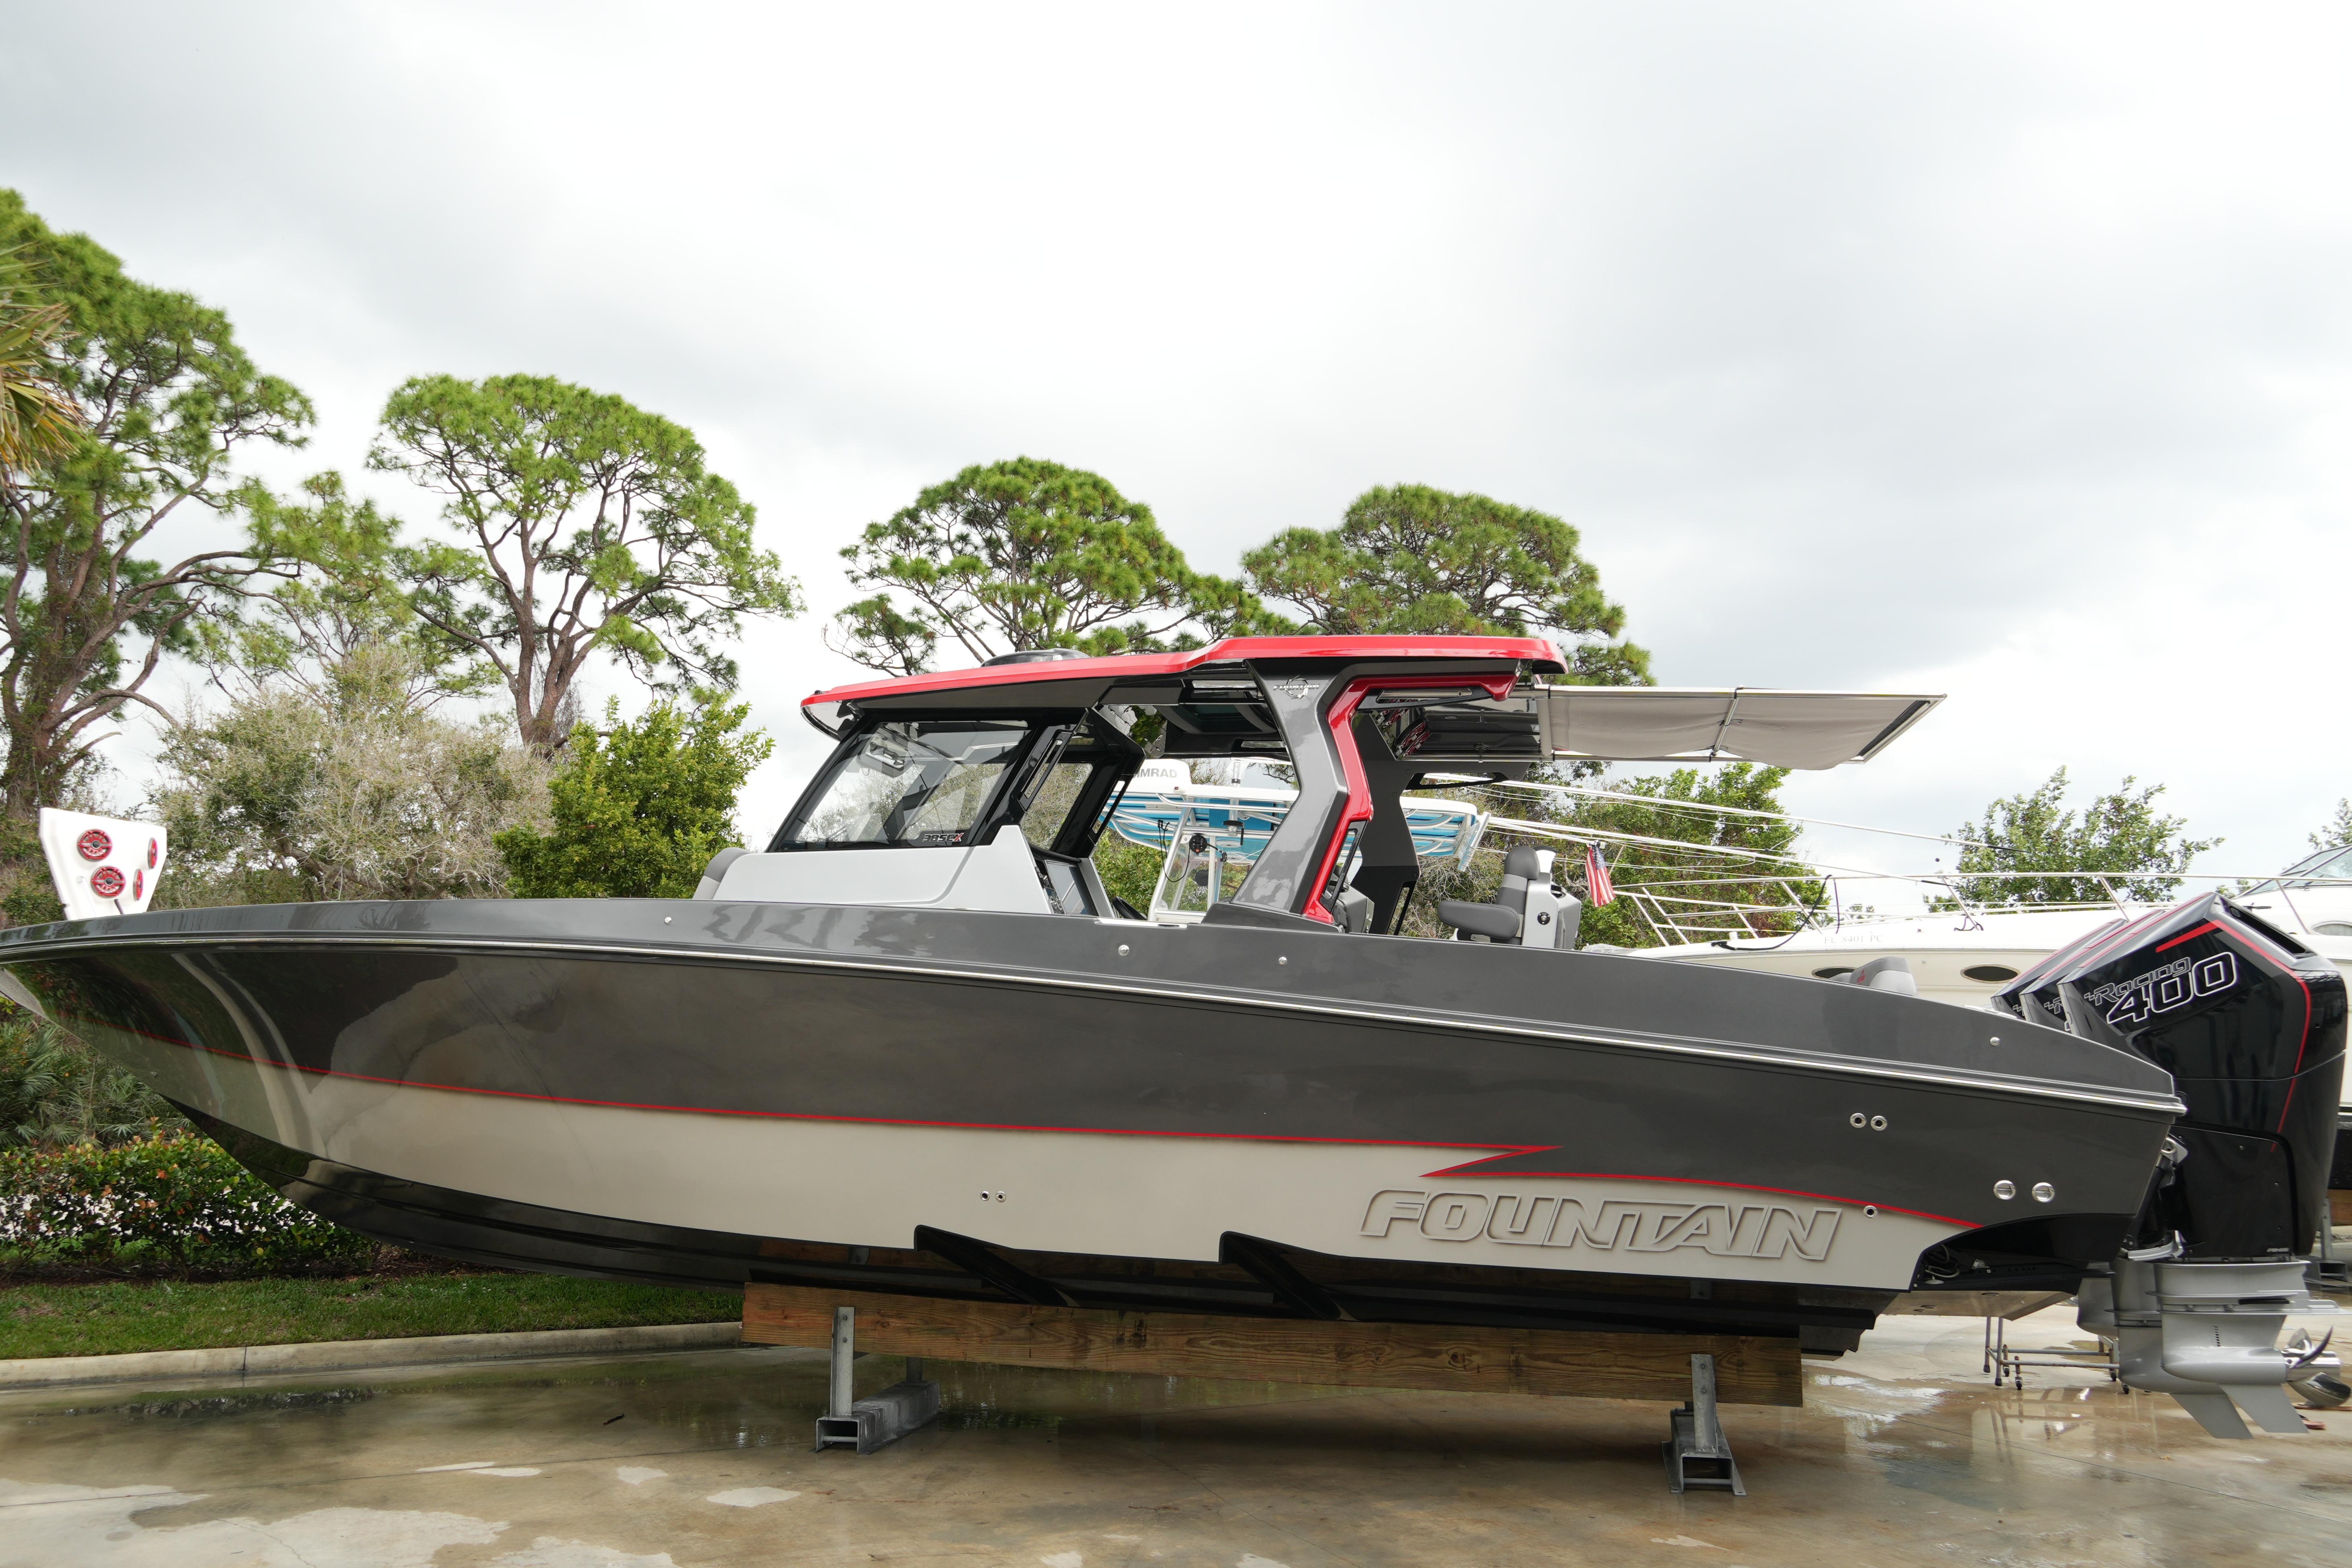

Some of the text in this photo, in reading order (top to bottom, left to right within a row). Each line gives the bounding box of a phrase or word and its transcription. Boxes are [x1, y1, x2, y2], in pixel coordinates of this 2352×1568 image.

[1134, 768, 1177, 778] IMRAD
[922, 833, 964, 843] 38SCX
[1841, 935, 1863, 943] 8401
[1870, 934, 1884, 942] PC
[2090, 957, 2192, 1007] Racing
[2106, 951, 2237, 1024] 400
[1357, 1189, 1842, 1260] FOUNTAIN
